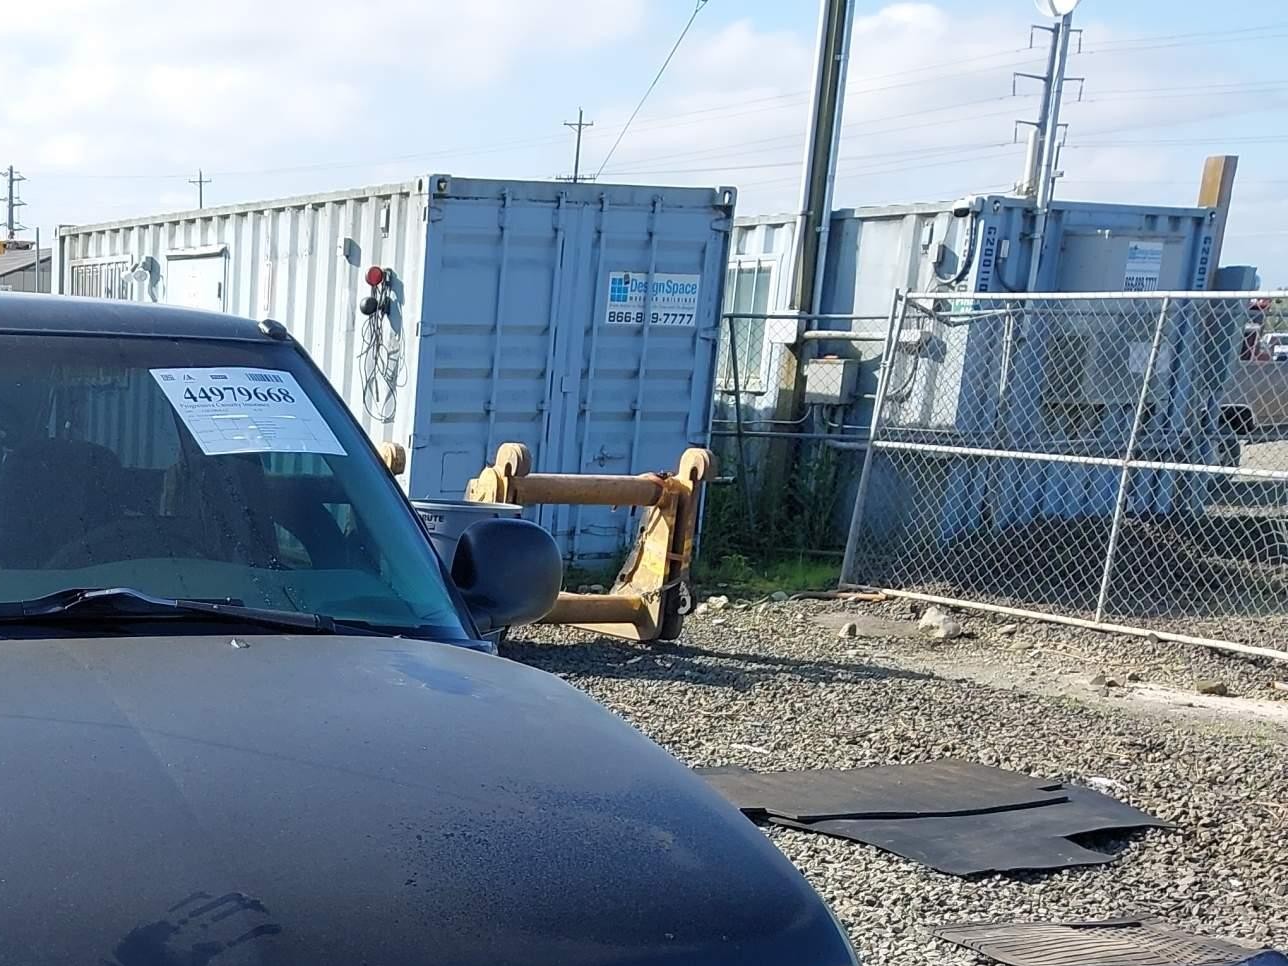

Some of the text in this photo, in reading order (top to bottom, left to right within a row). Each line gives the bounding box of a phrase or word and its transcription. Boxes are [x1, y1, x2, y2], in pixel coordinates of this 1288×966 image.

[630, 279, 697, 297] DesgnSpace
[608, 311, 693, 325] 866-89-7777
[183, 386, 296, 403] 44979668
